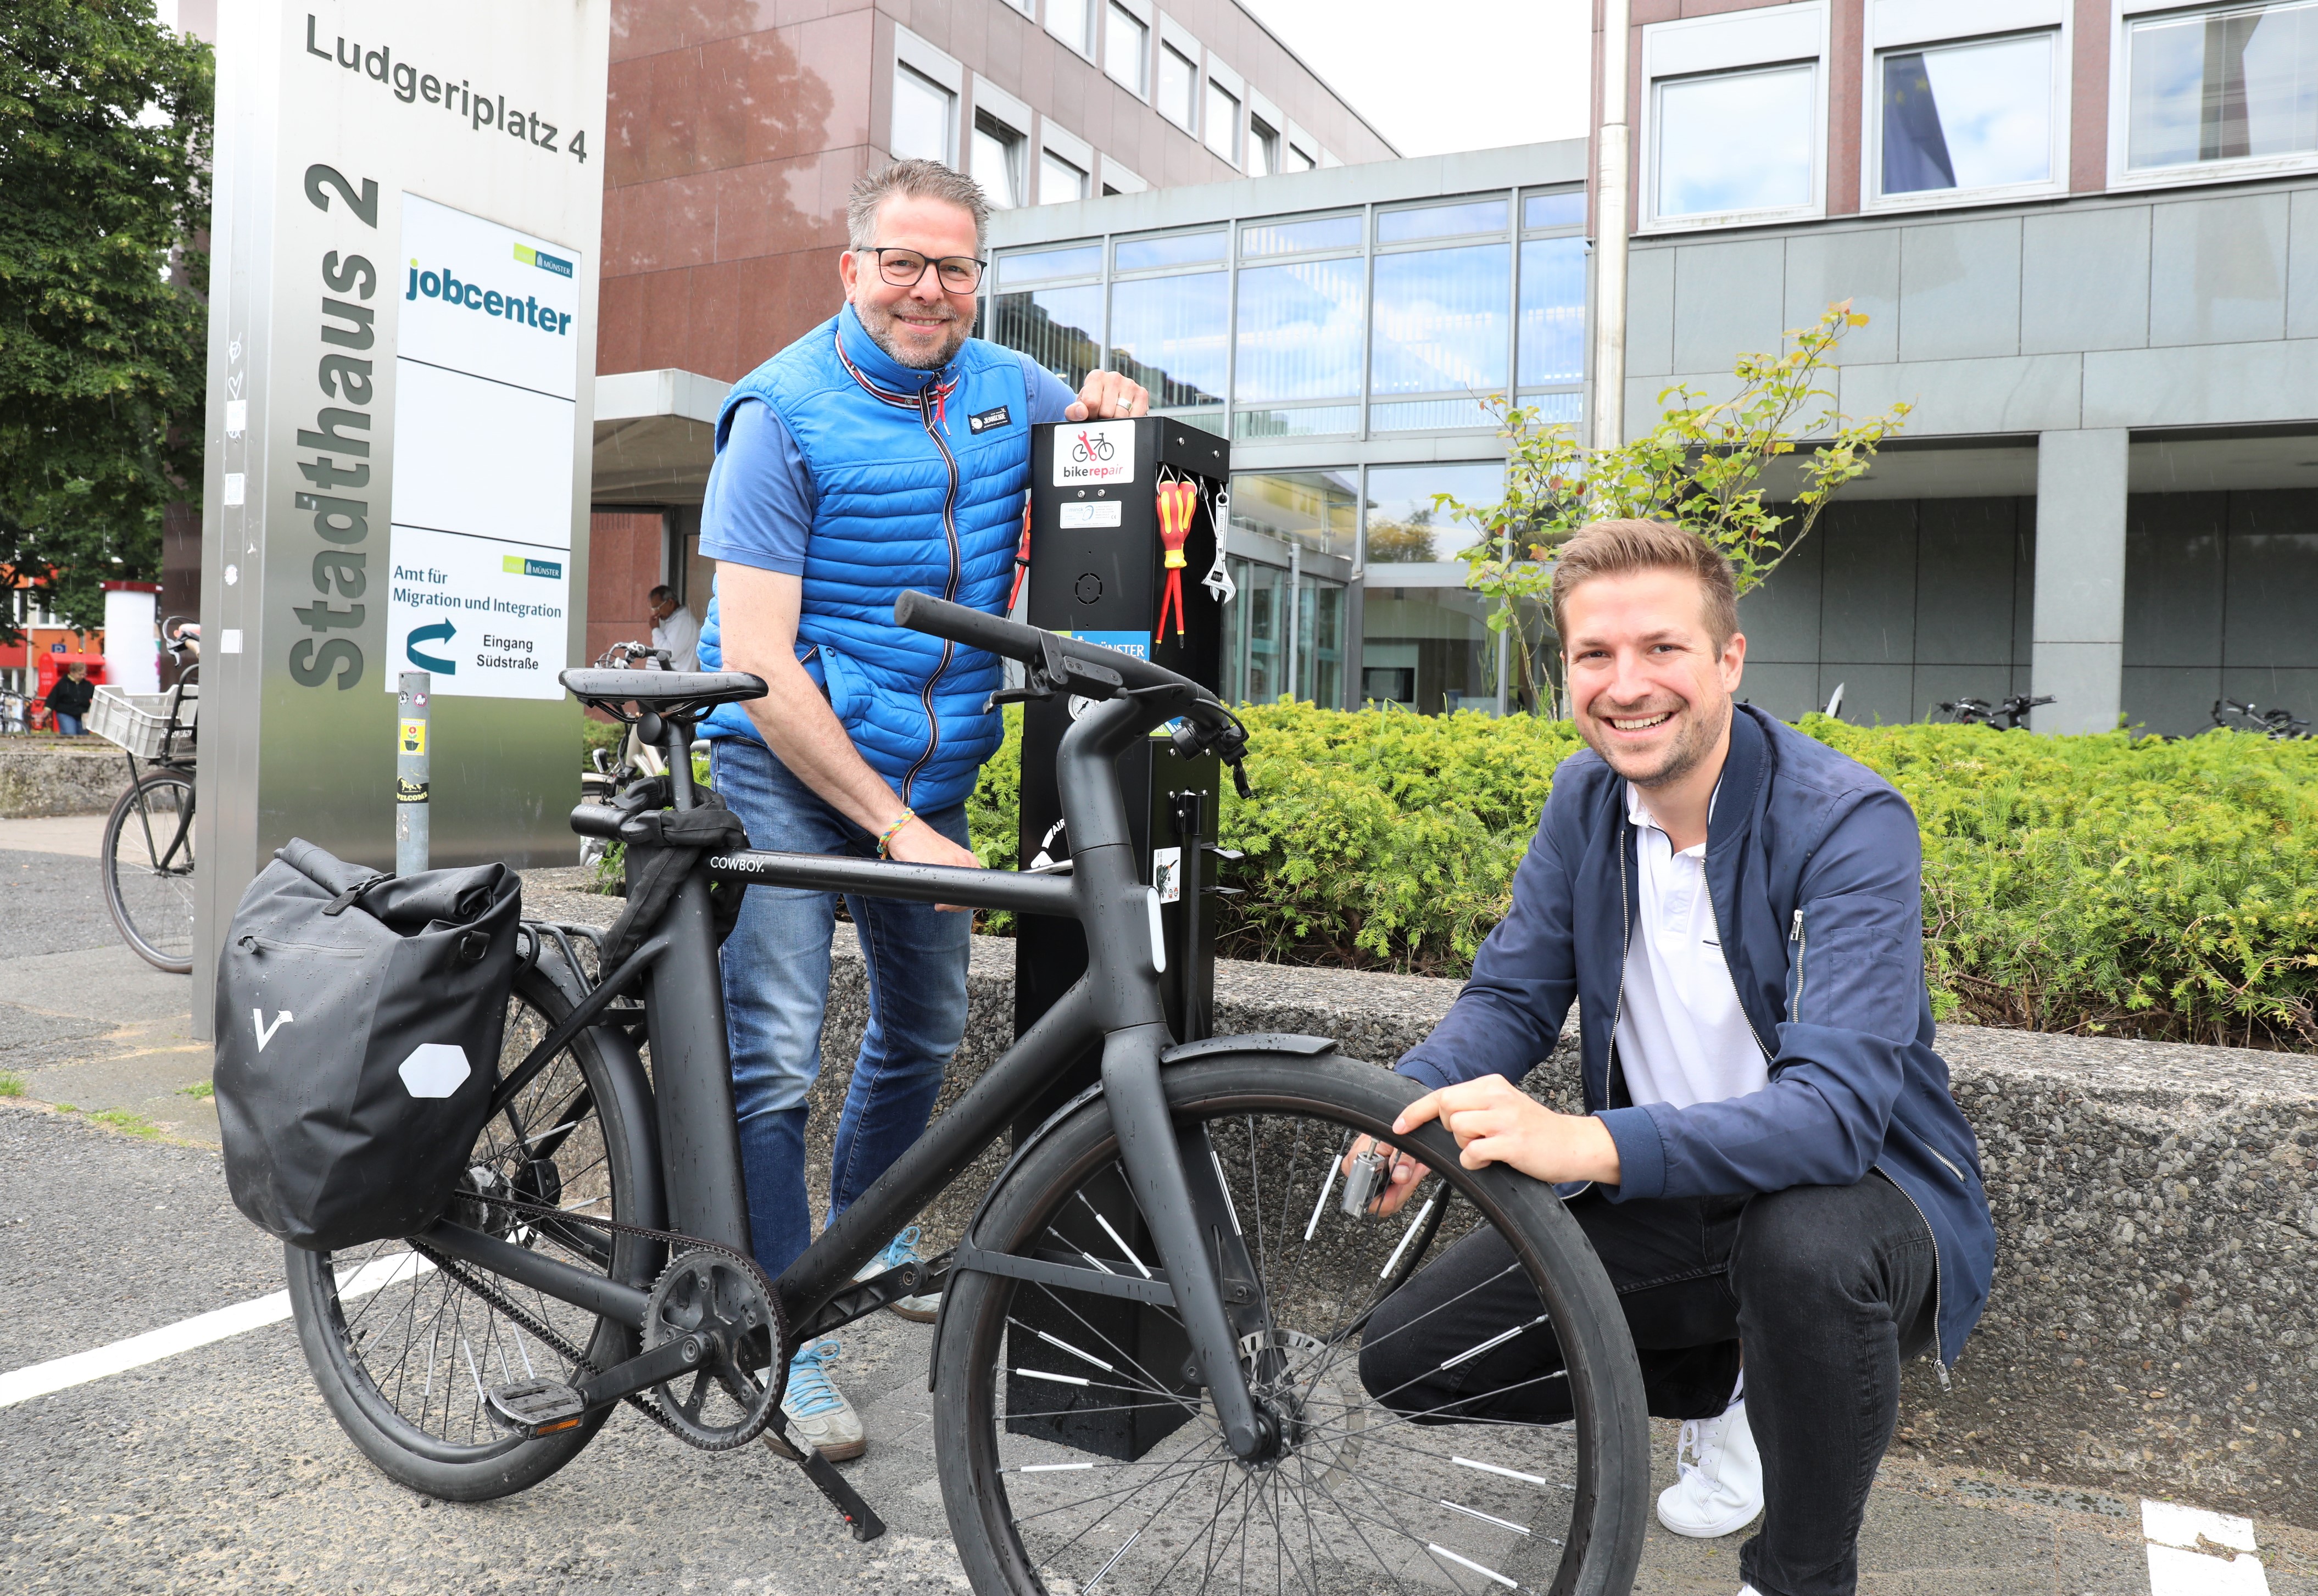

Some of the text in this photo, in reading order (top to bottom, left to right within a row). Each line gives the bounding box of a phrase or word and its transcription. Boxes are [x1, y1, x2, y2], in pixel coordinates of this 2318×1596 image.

[307, 14, 587, 164] Ludgeriplatz 4
[543, 260, 571, 275] MÜNSTER
[406, 258, 571, 336] jobcenter
[289, 164, 378, 691] Stadthaus 2
[1063, 464, 1123, 478] bikerepair
[394, 565, 448, 584] Amt für
[532, 566, 559, 577] MÜNSTER
[393, 588, 561, 618] Migration und Integration
[483, 634, 533, 652] Eingang
[477, 655, 538, 669] Südstraße
